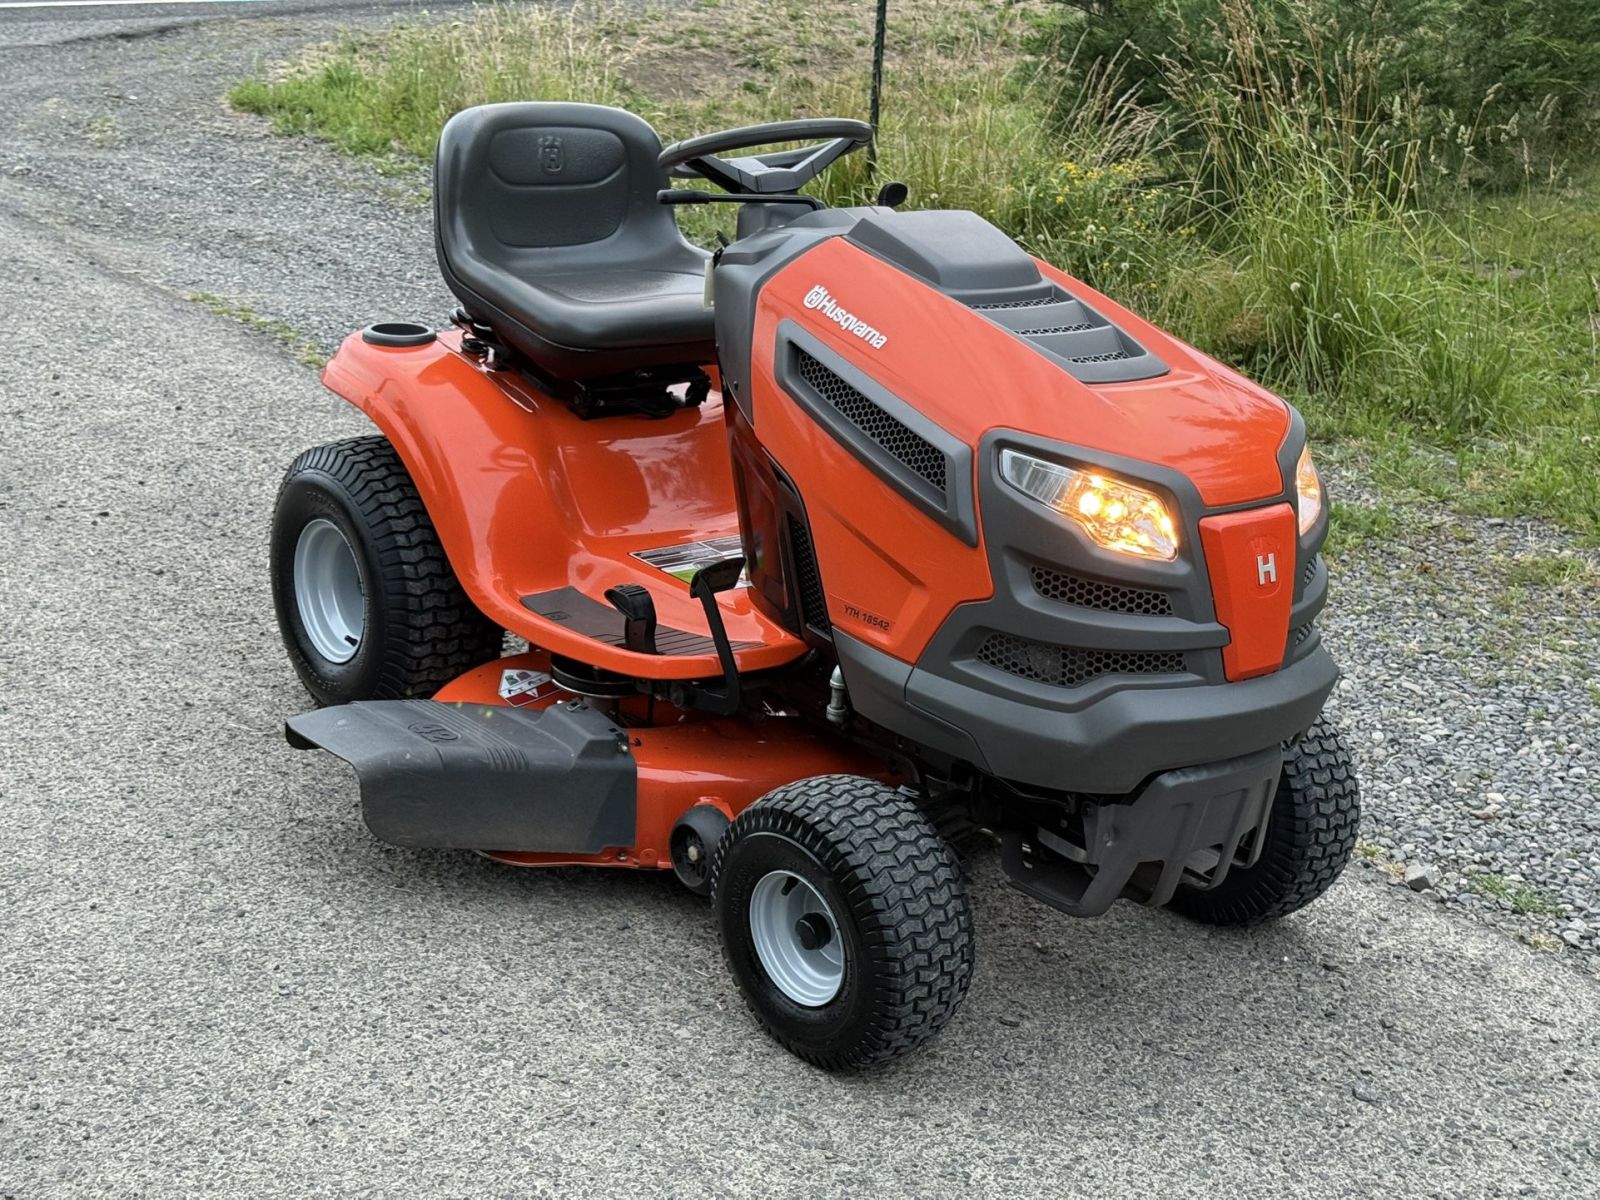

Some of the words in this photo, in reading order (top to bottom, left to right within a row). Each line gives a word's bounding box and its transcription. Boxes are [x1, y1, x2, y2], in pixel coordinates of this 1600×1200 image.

[816, 294, 888, 349] Husqvarna
[1257, 553, 1277, 585] H
[844, 604, 860, 618] YTH
[862, 613, 890, 631] 18542
